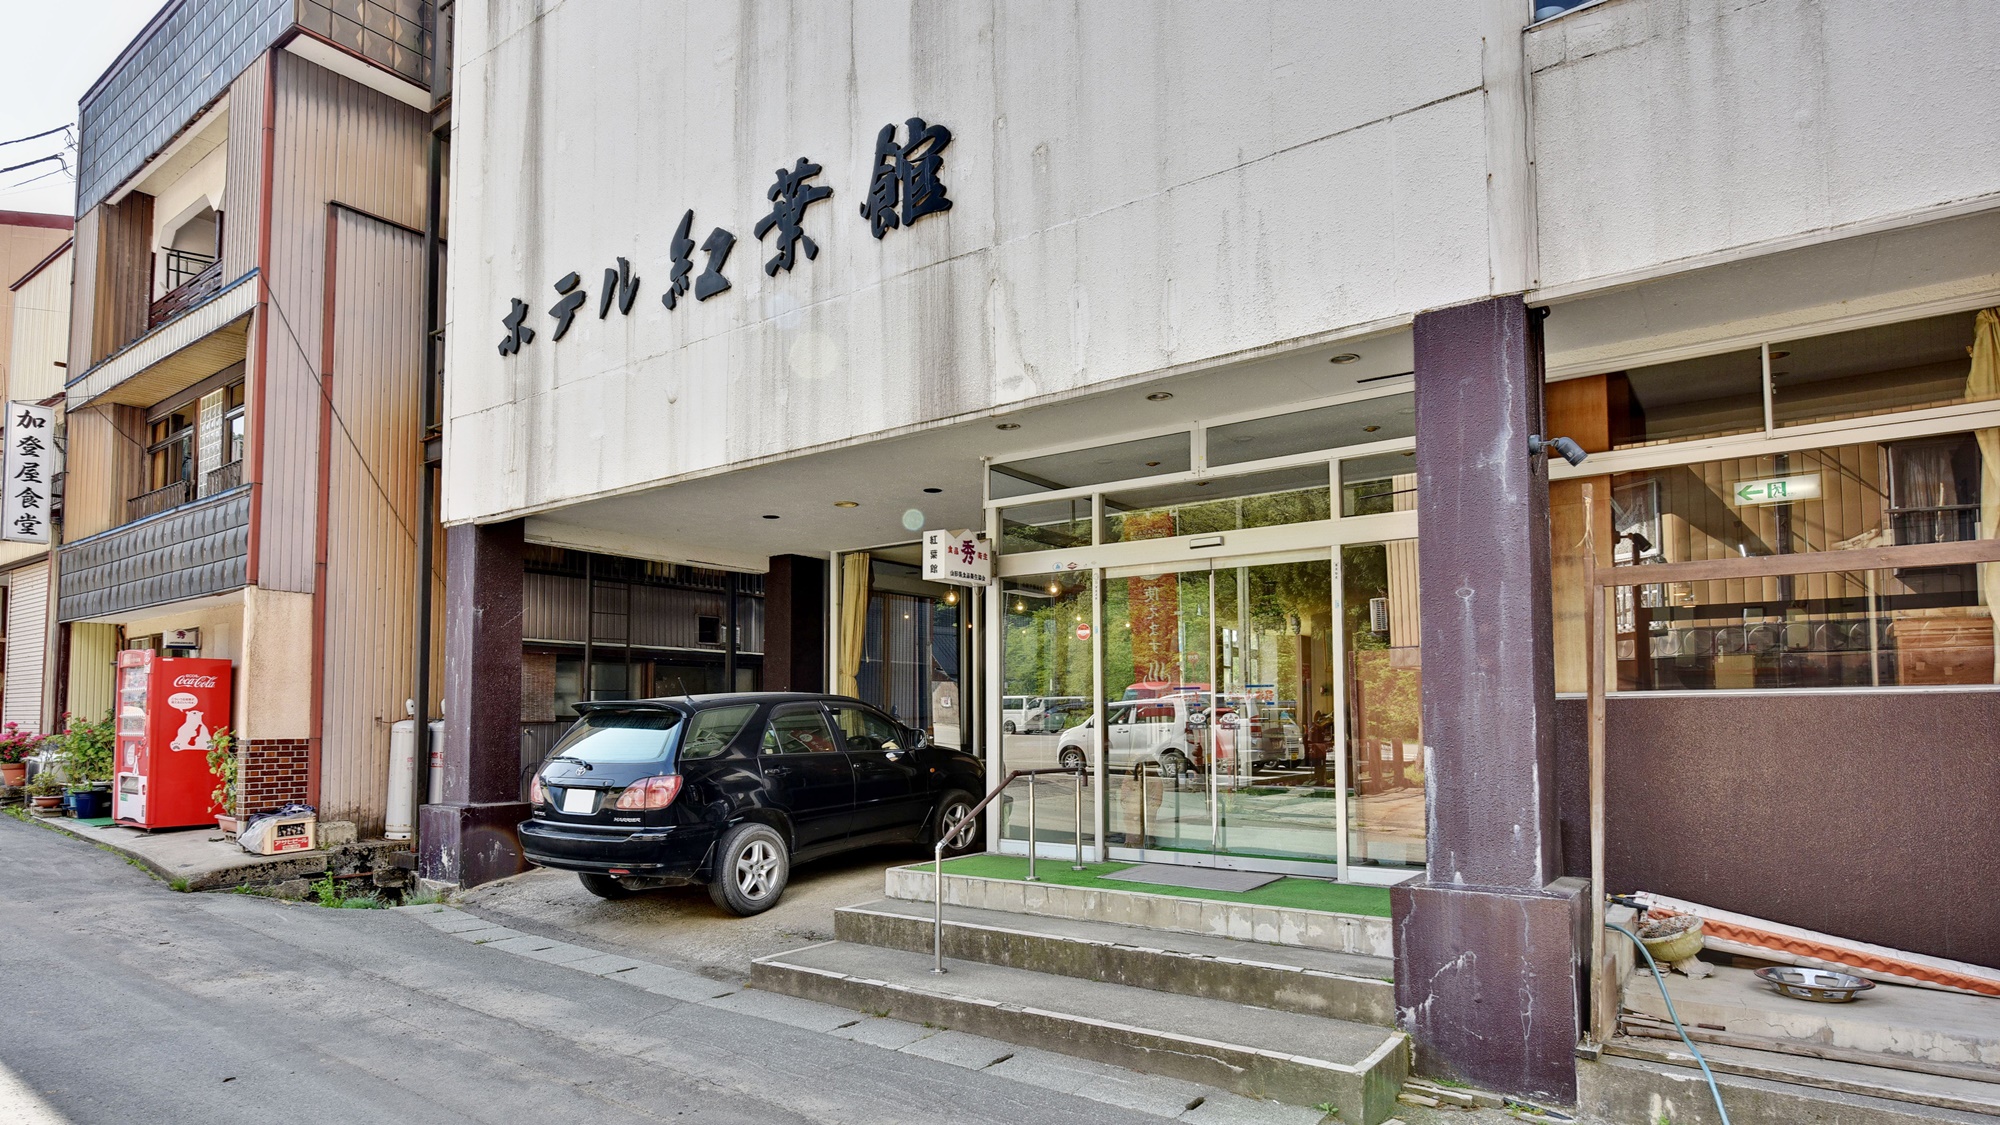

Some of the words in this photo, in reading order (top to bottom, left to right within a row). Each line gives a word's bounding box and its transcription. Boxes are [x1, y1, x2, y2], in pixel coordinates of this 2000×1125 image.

[497, 116, 953, 357] ホテル紅葉館
[14, 409, 46, 535] 加登屋食堂
[929, 535, 938, 574] 紅葉館
[961, 540, 976, 565] 秀
[173, 675, 218, 688] Coca-Cola
